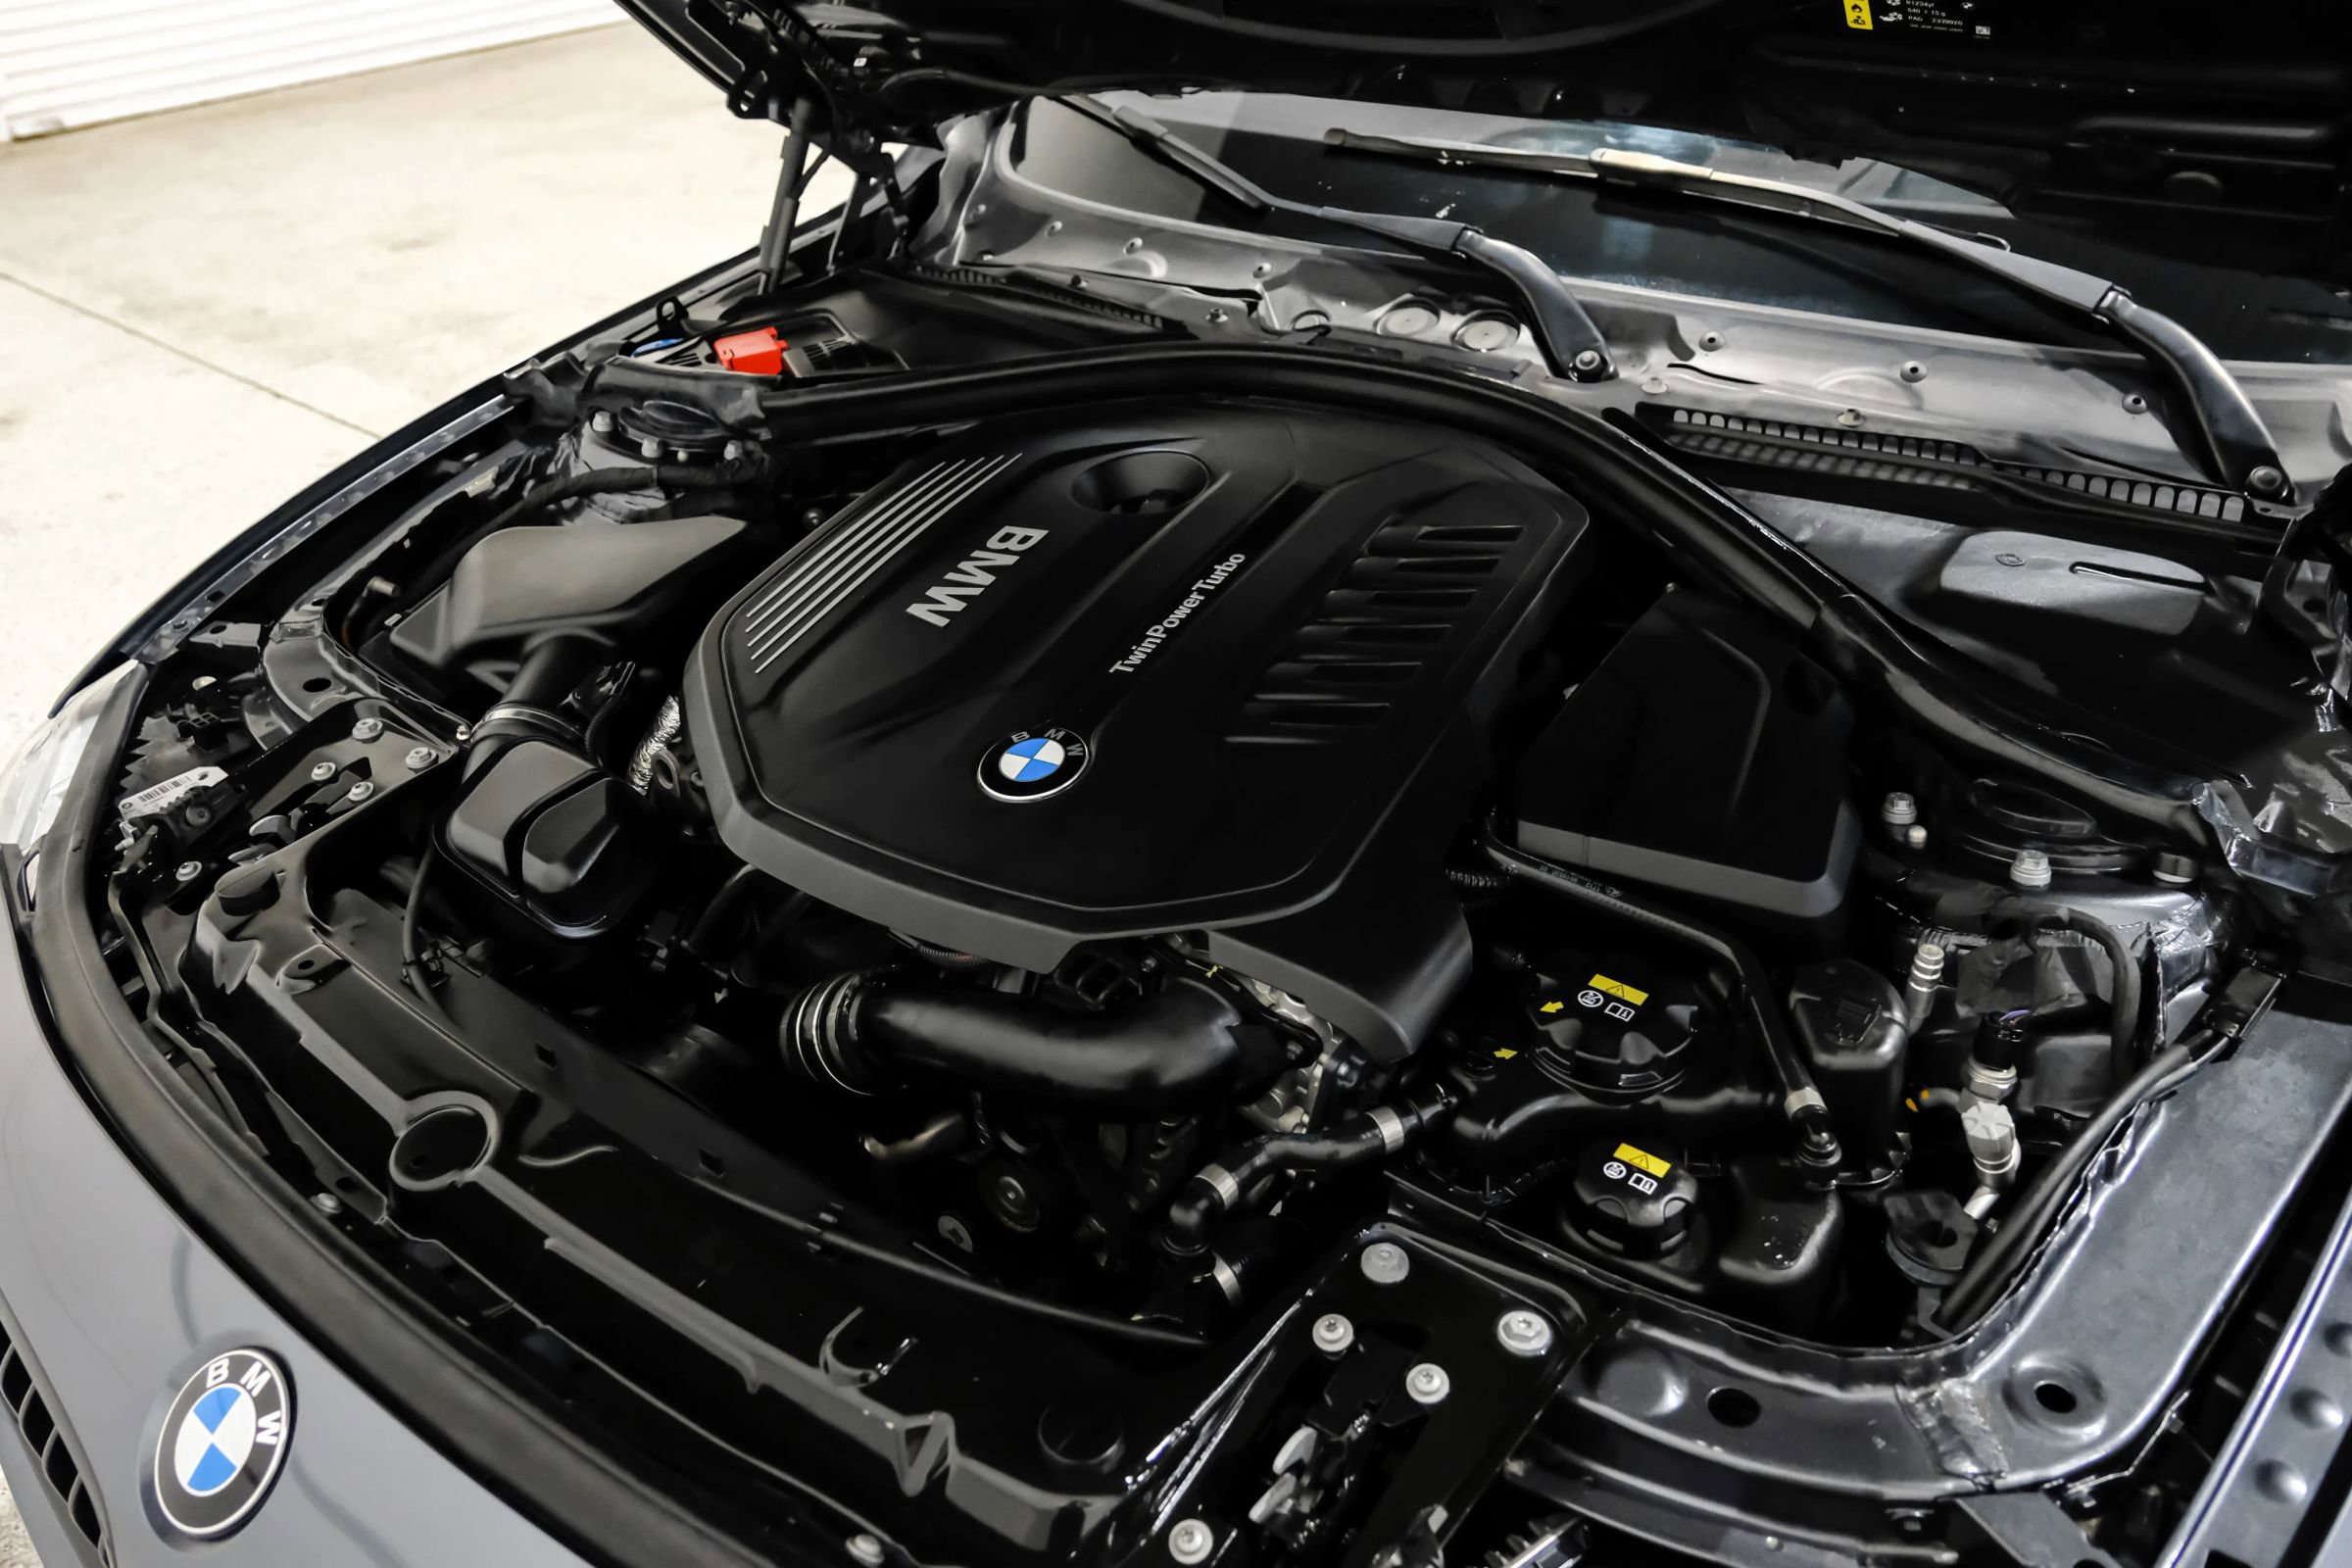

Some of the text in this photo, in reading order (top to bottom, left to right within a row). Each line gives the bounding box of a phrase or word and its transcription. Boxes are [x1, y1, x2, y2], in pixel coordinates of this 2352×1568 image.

[906, 525, 1050, 627] BMW
[1010, 728, 1084, 757] BMW
[206, 1357, 282, 1446] BMW
